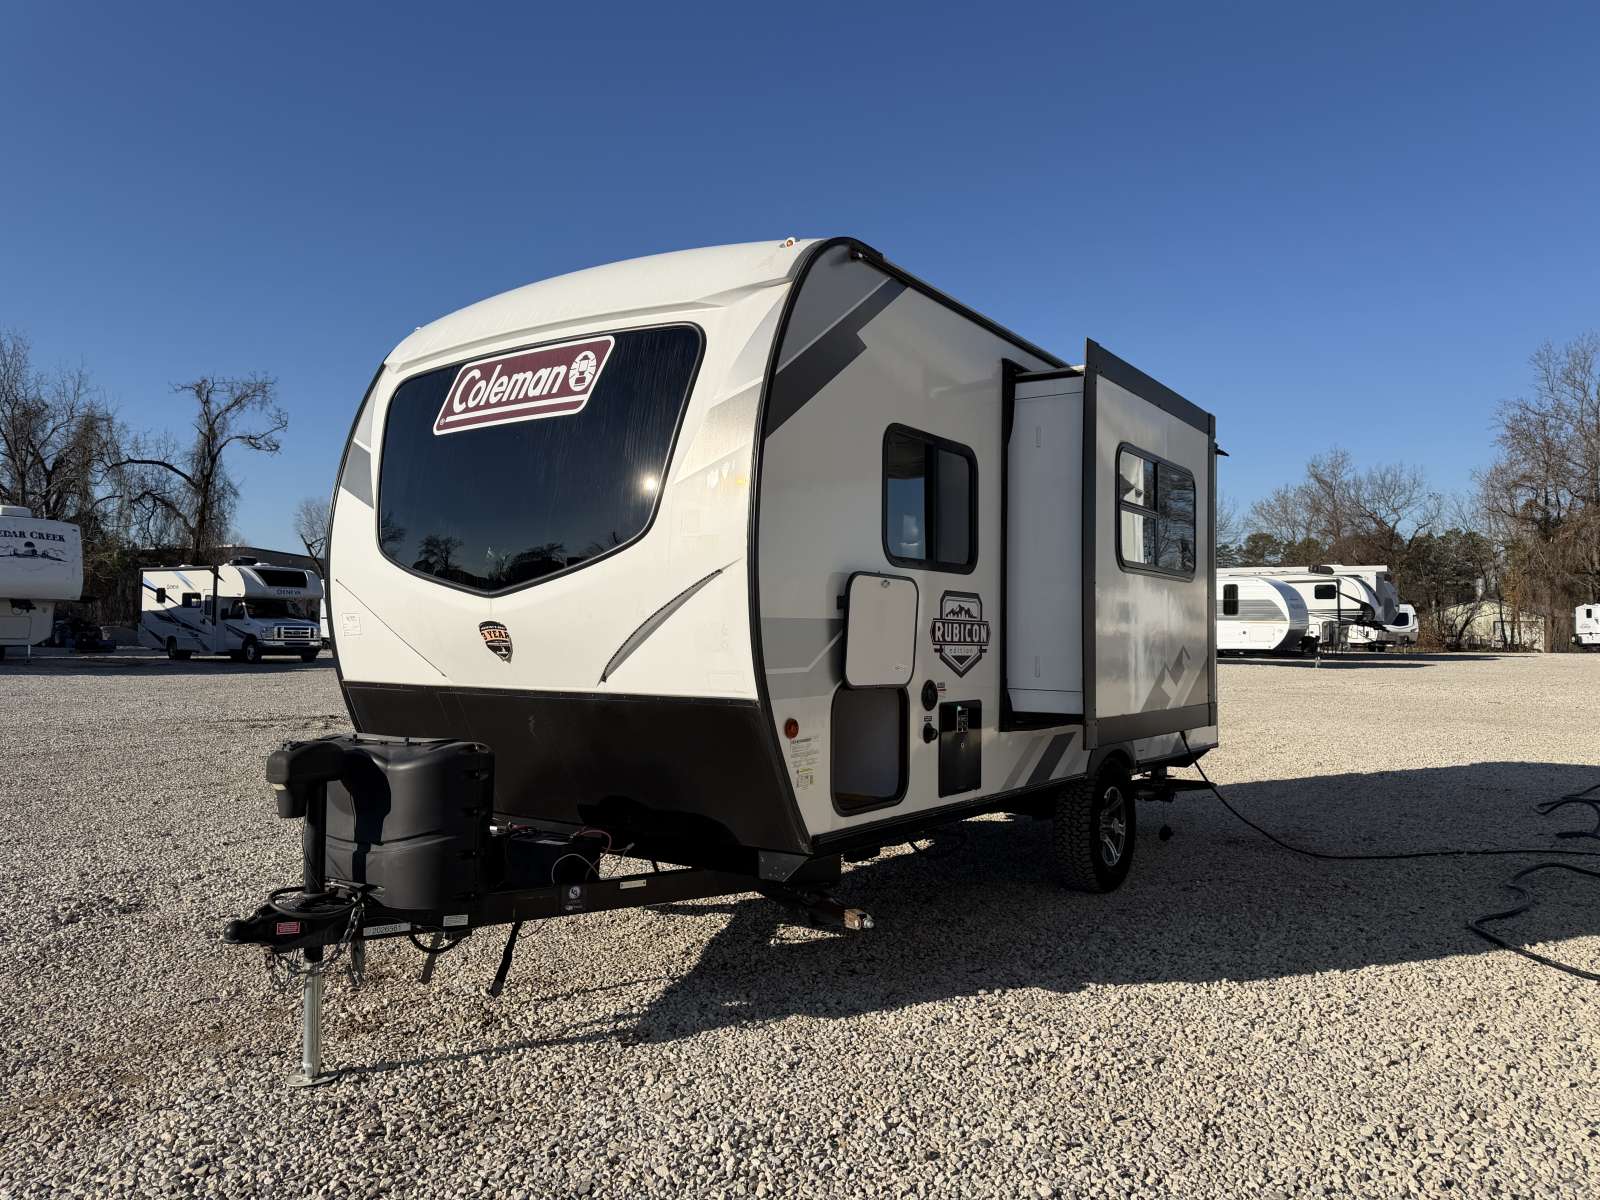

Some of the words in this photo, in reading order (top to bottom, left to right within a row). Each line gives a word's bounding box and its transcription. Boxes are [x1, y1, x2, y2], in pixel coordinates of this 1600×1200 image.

[453, 365, 567, 413] Coleman
[29, 531, 65, 542] CREEK
[487, 630, 510, 639] YEAR
[935, 621, 987, 643] RUBICON
[949, 647, 974, 655] edition
